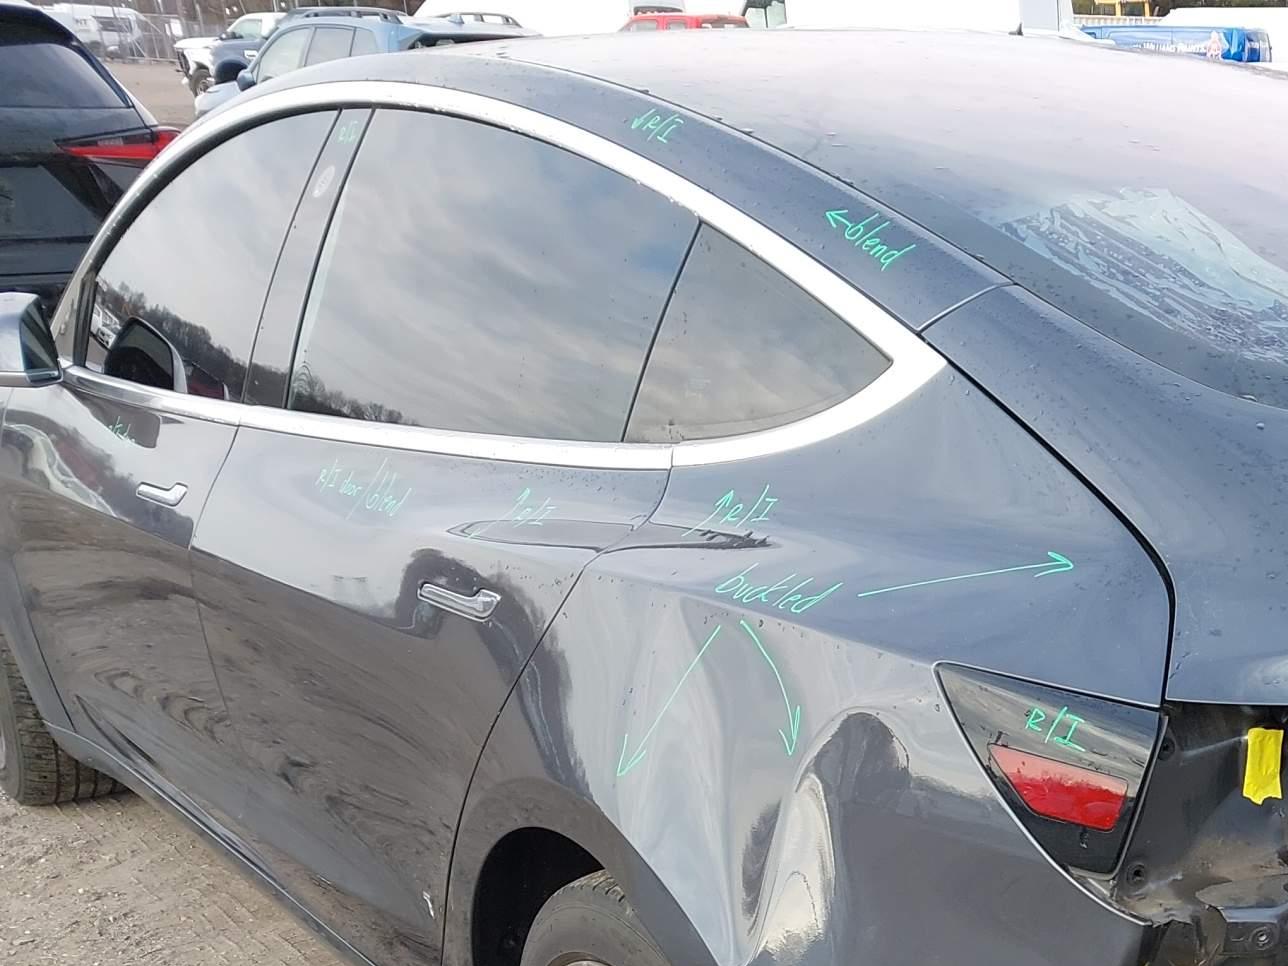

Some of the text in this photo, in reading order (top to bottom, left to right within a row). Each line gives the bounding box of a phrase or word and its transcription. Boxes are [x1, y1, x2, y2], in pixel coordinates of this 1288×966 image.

[845, 211, 917, 272] blend
[719, 484, 779, 528] R/I
[714, 562, 844, 613] buckled
[1024, 706, 1086, 752] R/I
